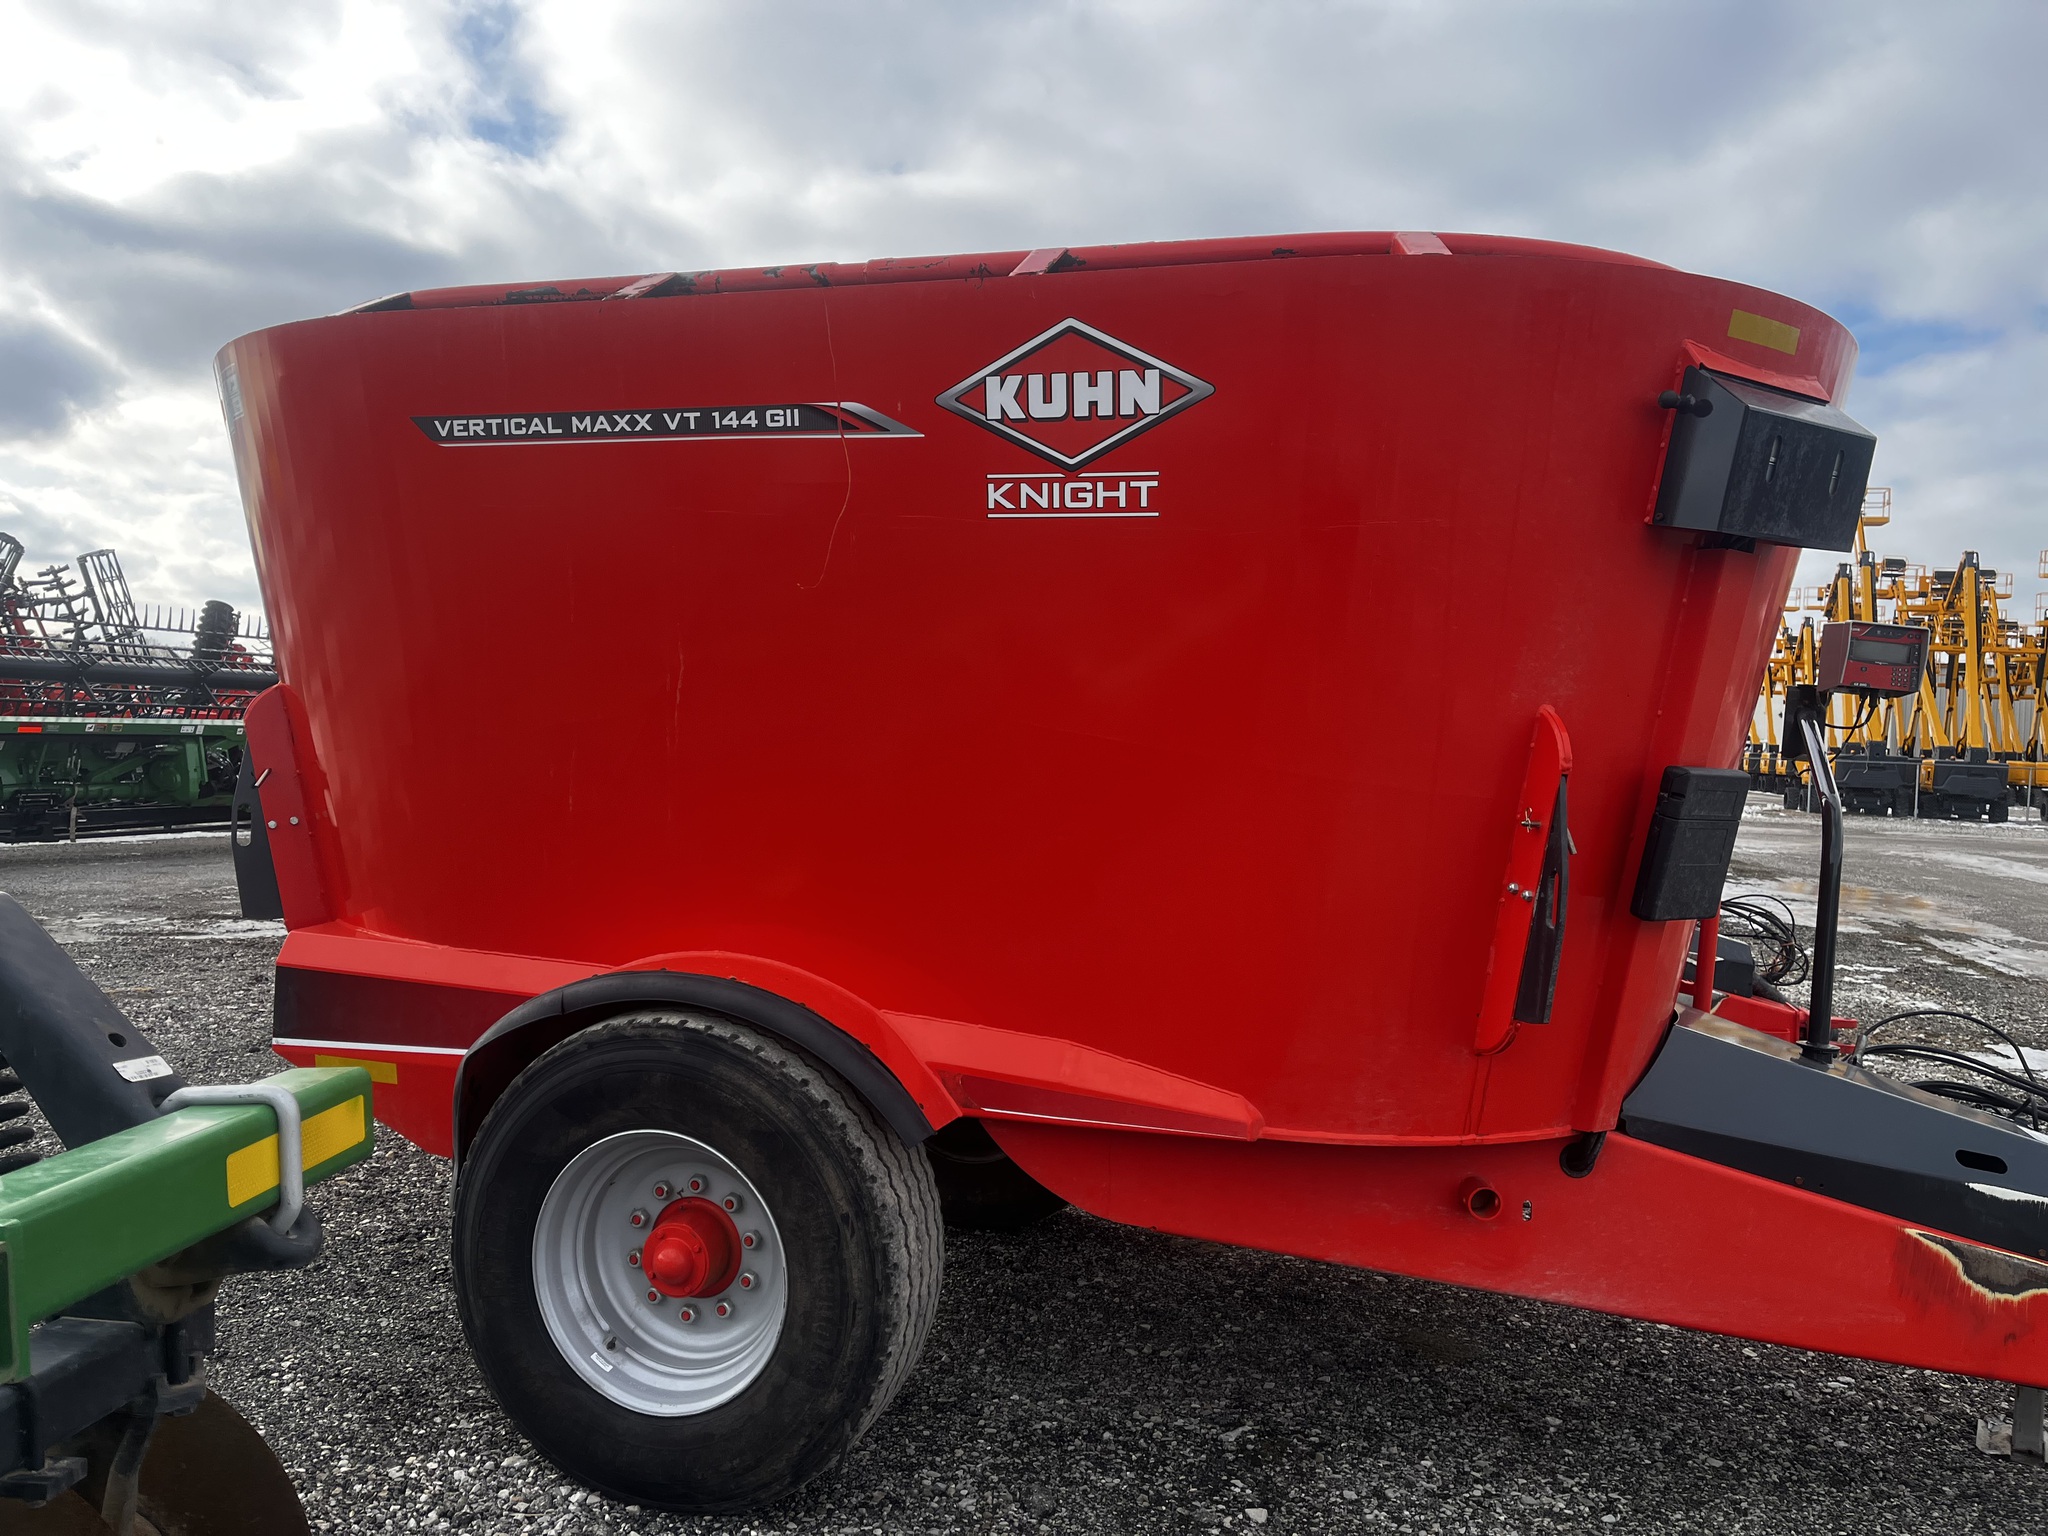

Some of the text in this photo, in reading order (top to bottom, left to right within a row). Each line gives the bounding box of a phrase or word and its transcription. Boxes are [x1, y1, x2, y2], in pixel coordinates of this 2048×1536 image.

[984, 368, 1161, 421] KUHN
[433, 408, 801, 437] VERTICAL MAXX VT 144 GII
[987, 481, 1160, 509] KNIGHT
